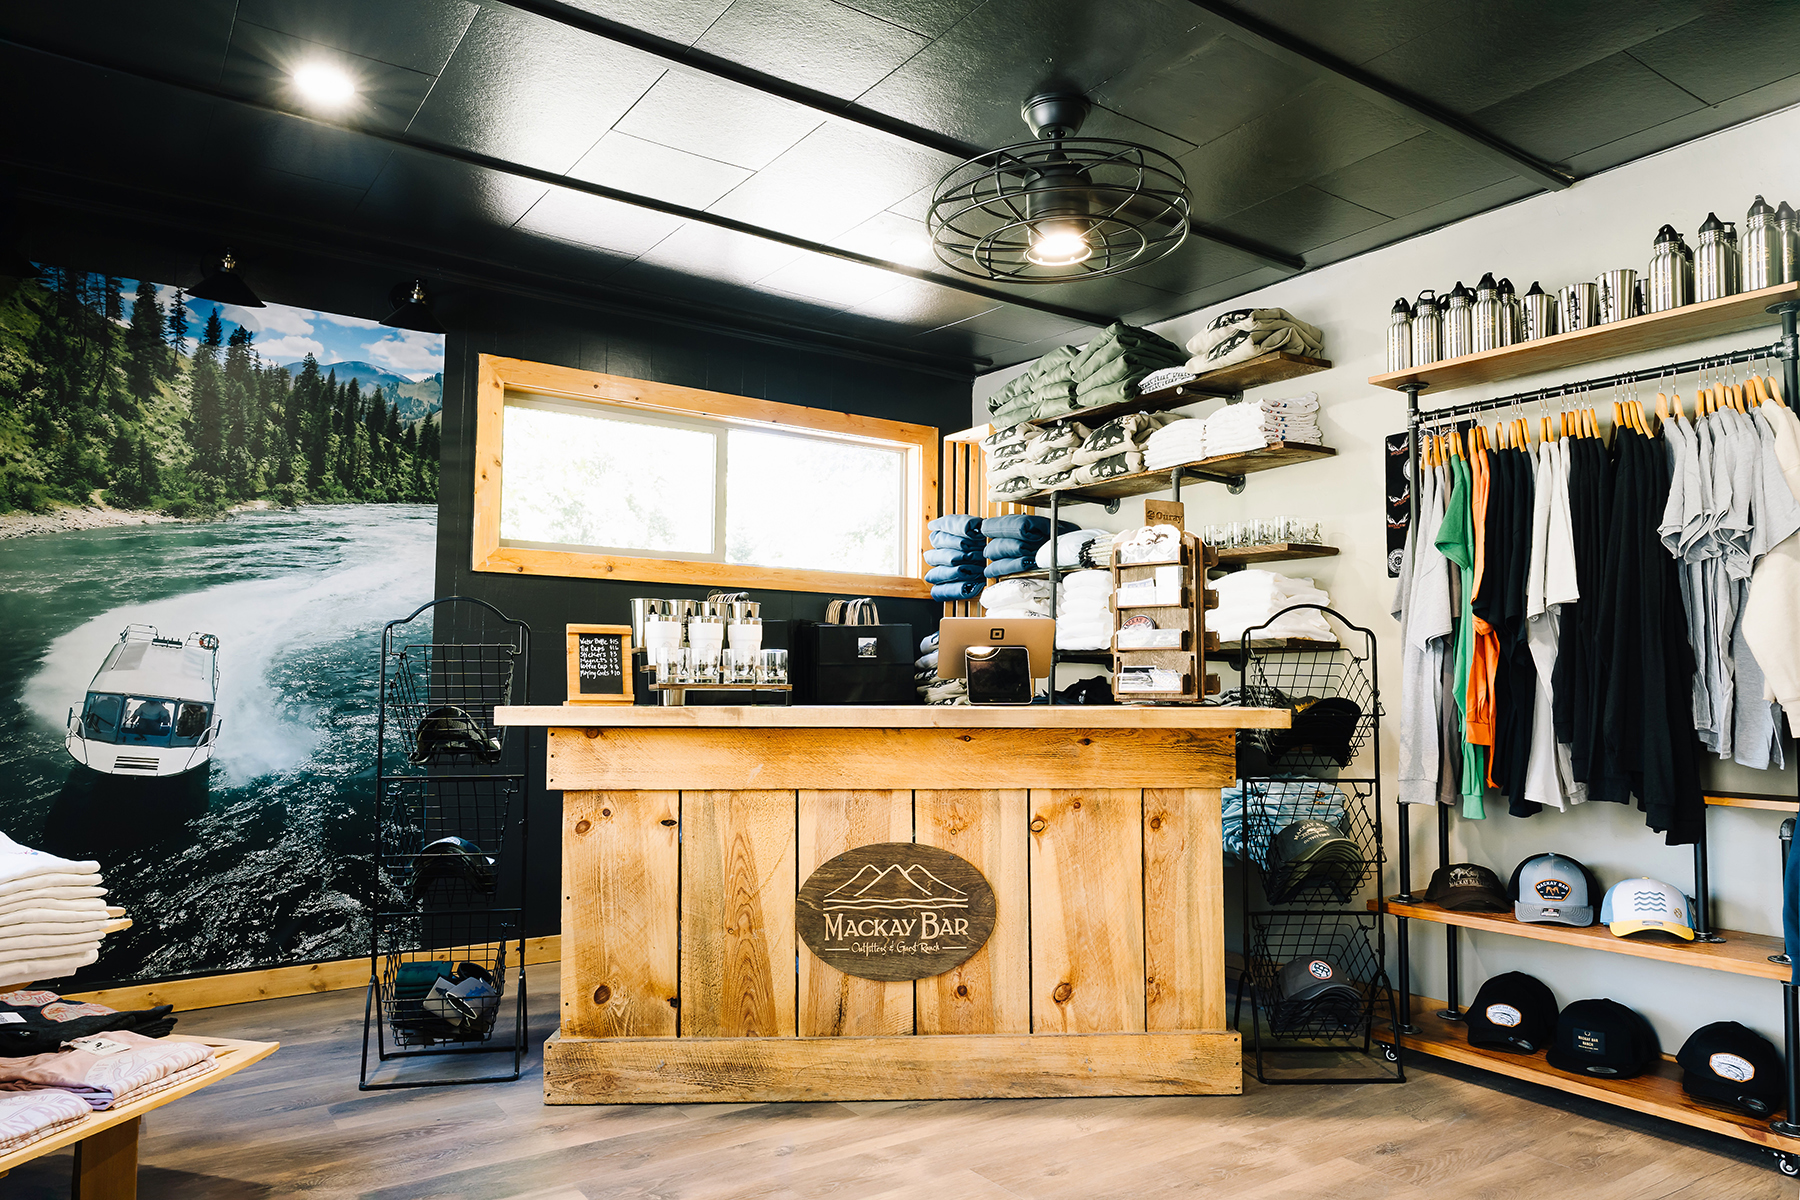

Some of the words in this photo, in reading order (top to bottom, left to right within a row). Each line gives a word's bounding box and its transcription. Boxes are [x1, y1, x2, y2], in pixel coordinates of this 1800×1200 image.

[1156, 511, 1184, 524] Ouray
[1536, 881, 1557, 890] MACKAY
[823, 912, 917, 941] MACKAY
[920, 911, 969, 940] BAR
[851, 941, 887, 957] Outfitters
[896, 940, 918, 957] Guest
[918, 941, 940, 954] Ranch
